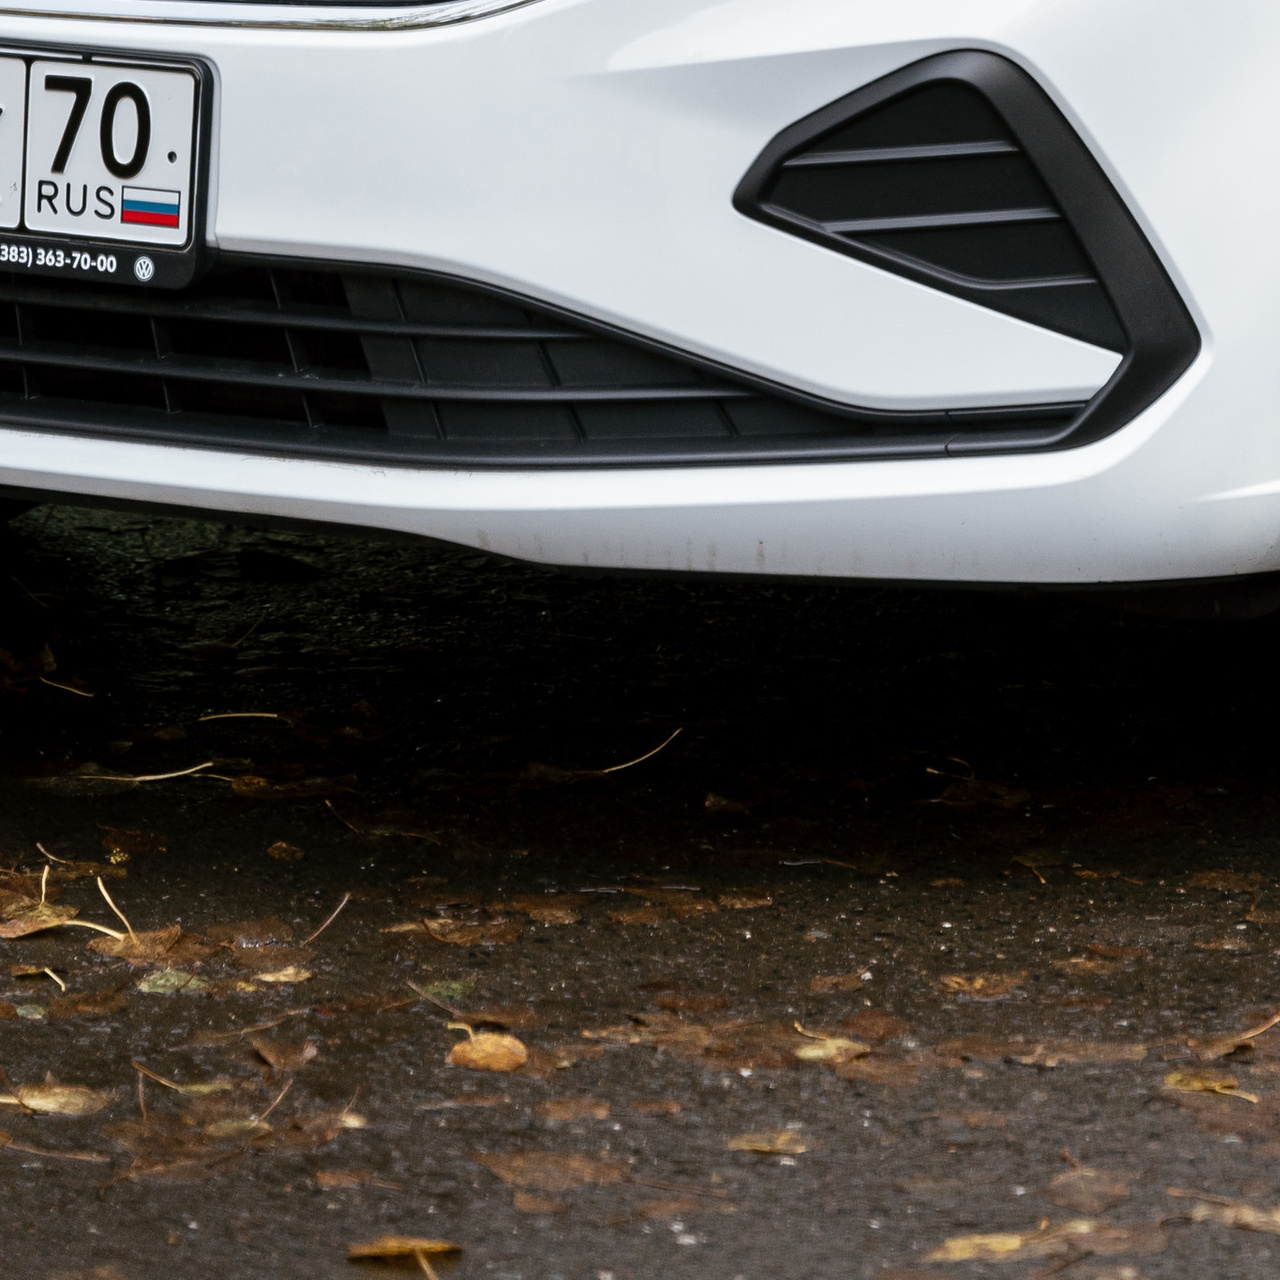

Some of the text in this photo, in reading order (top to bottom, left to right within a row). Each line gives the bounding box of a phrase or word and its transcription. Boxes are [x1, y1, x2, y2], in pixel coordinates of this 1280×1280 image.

[44, 74, 151, 179] 70
[36, 179, 116, 220] RUS
[36, 247, 117, 273] 363-70-00
